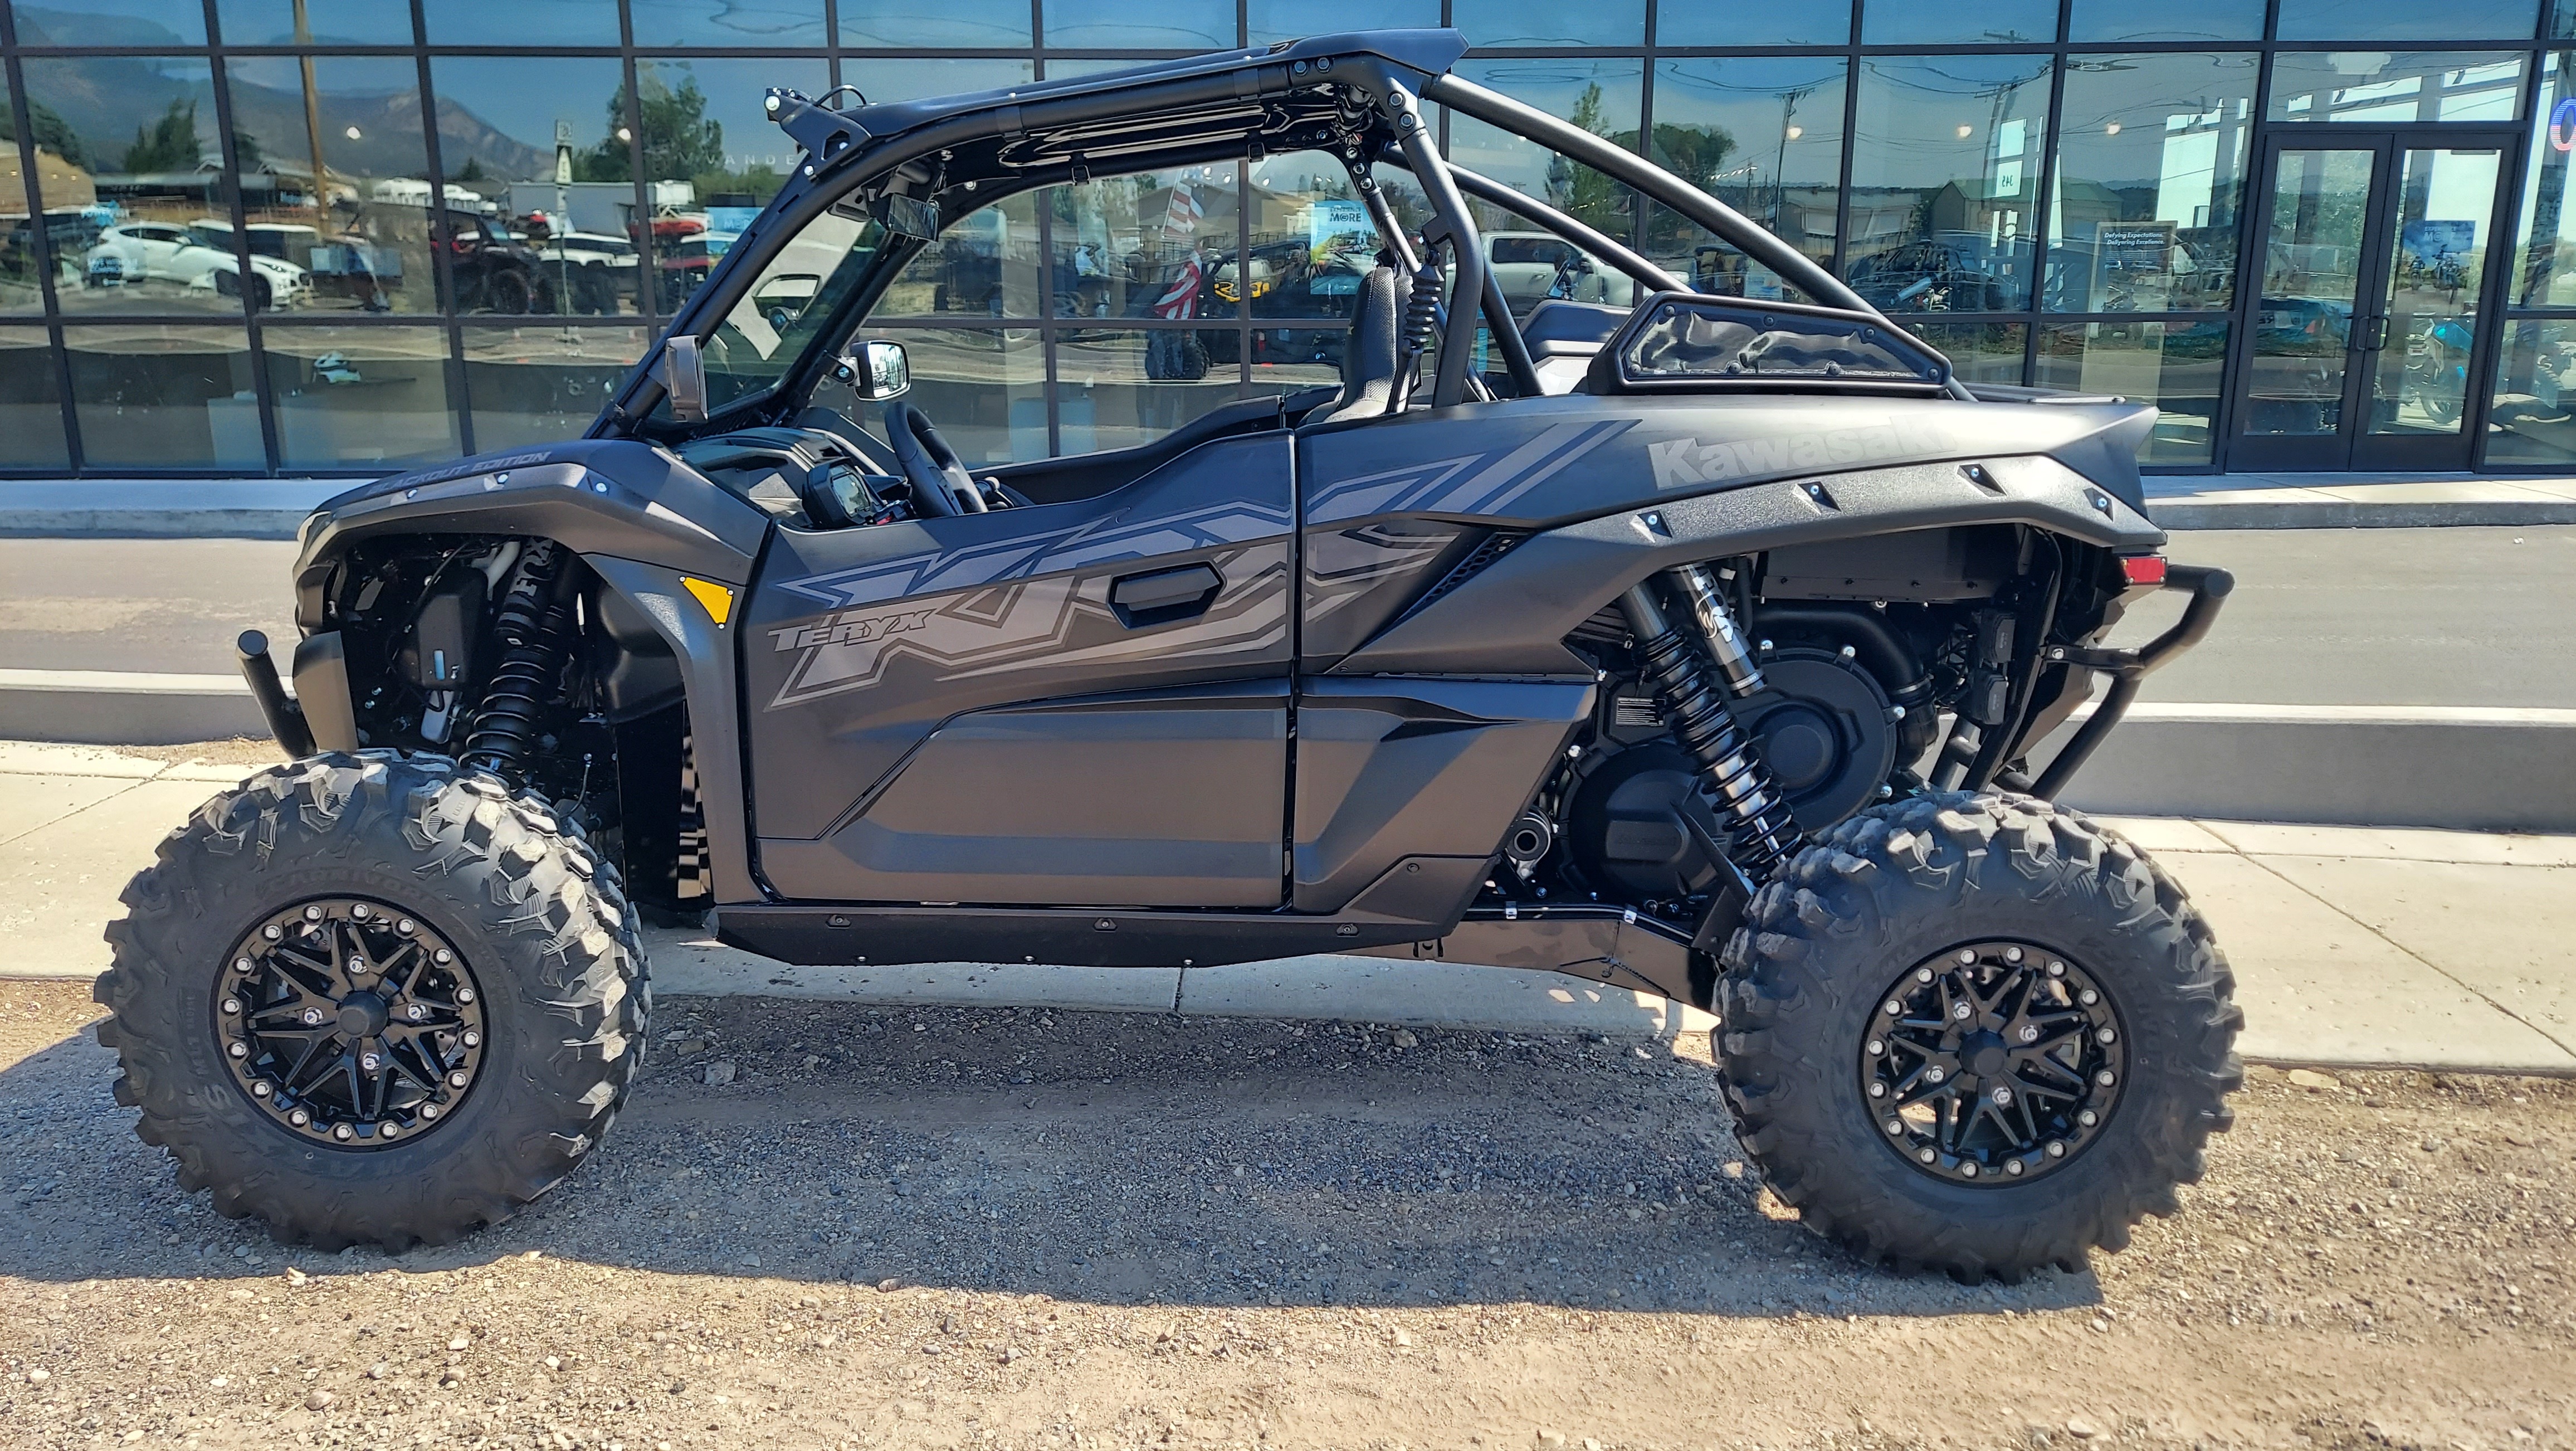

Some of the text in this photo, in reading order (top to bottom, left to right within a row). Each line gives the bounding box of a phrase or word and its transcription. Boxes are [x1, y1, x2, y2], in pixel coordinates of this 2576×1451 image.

[364, 451, 552, 497] BLACKOUT EDITION
[768, 608, 937, 652] TERYX
